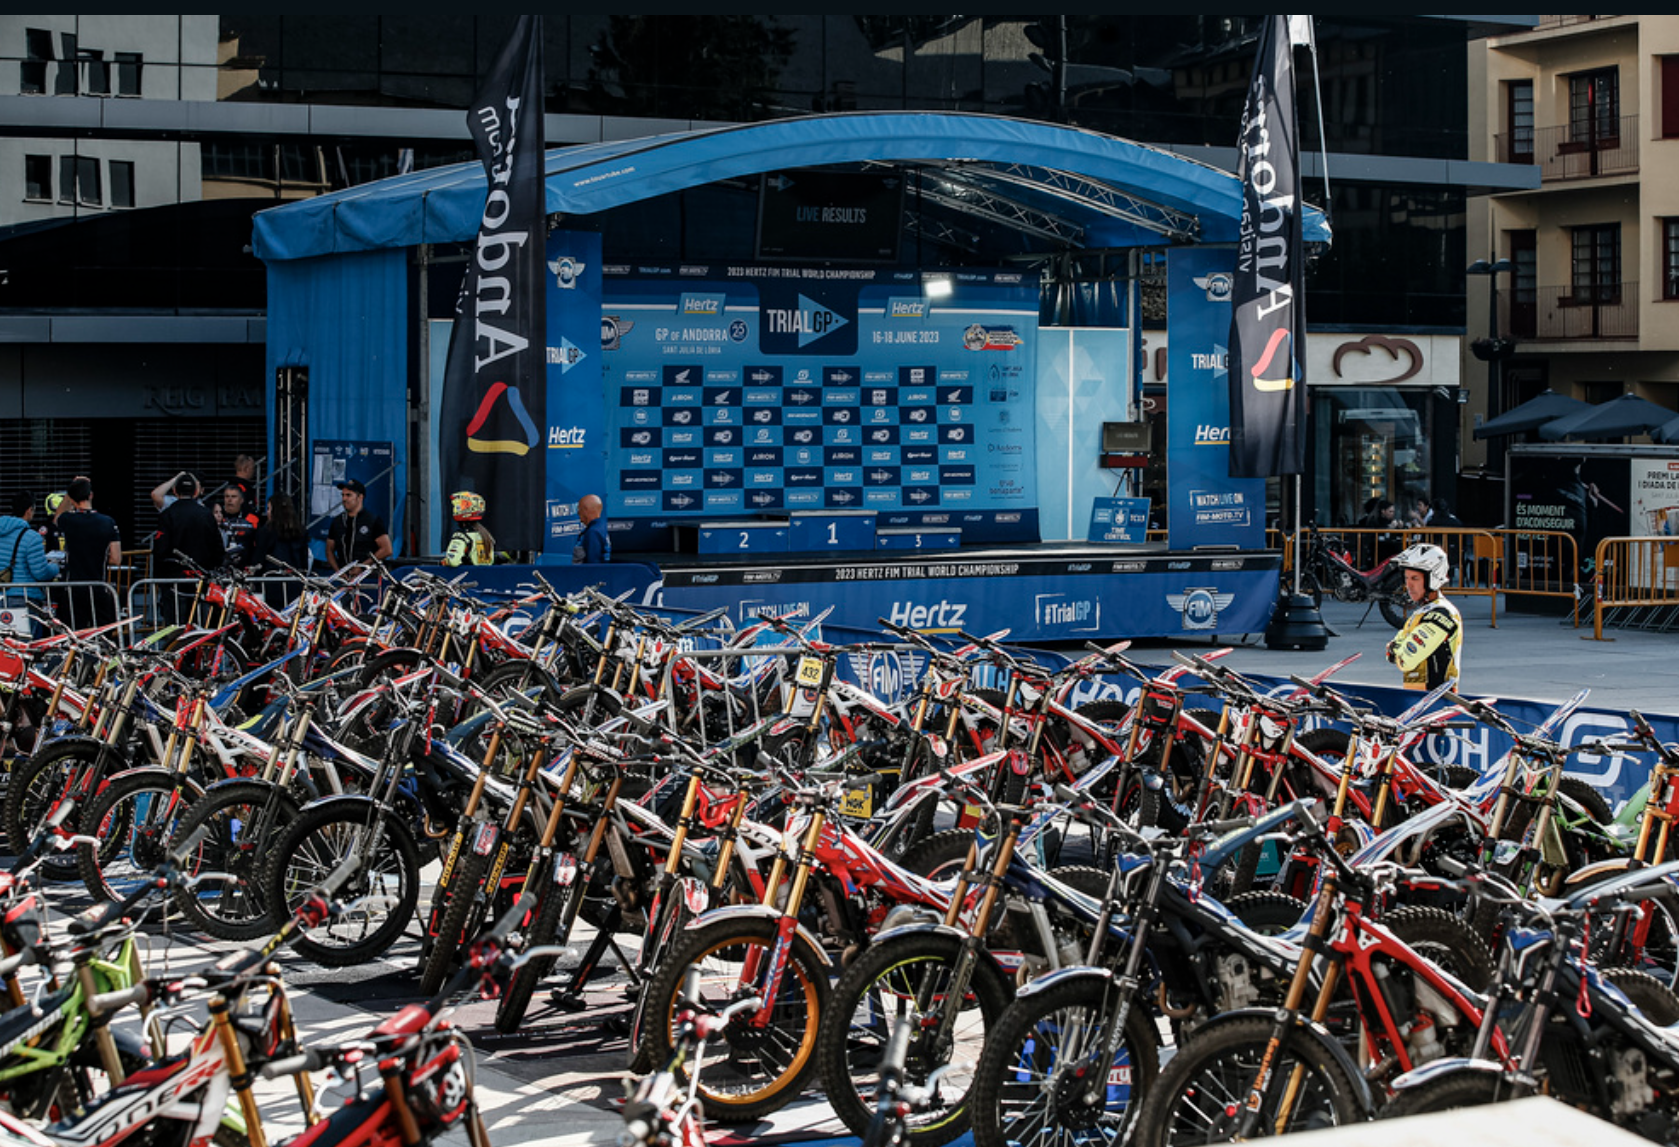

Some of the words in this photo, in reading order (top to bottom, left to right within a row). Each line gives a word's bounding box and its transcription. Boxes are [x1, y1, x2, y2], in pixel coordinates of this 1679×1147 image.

[797, 206, 820, 222] LIVE
[822, 207, 866, 223] RESULTS
[728, 267, 744, 276] 2023
[746, 267, 766, 277] HERTZ
[768, 268, 780, 277] FIM
[782, 268, 800, 278] TRIAL
[802, 269, 824, 279] WORLD
[826, 270, 875, 279] CHAMPIONSHIP
[684, 298, 718, 310] Hertz
[892, 302, 925, 314] Hertz
[655, 328, 669, 341] GP
[670, 331, 680, 341] OF
[683, 328, 728, 341] ANDORRA
[873, 331, 893, 343] 16-18
[894, 331, 917, 343] JUNE
[920, 331, 939, 343] 2023
[549, 426, 585, 444] Hertz
[1648, 471, 1669, 480] PREMI
[1643, 480, 1665, 489] DIADA
[1196, 494, 1219, 506] WATCH
[1220, 494, 1233, 505] LIVE
[1234, 493, 1244, 503] ON
[551, 504, 570, 518] WATCH
[1516, 502, 1526, 515] ÉS
[1527, 505, 1566, 516] MOMENT
[1516, 516, 1575, 529] D'ACONSEGUIR
[827, 522, 838, 543] 1
[739, 532, 749, 548] 2
[915, 534, 922, 547] 3
[836, 569, 855, 579] 2023
[857, 568, 883, 579] HERTZ
[885, 567, 900, 578] FIM
[902, 566, 925, 577] TRIAL
[928, 566, 955, 576] WORLD
[958, 564, 1019, 576] CHAMPIONSHIP
[748, 605, 777, 618] WATCH
[891, 600, 967, 627] Hertz
[1045, 600, 1091, 625] #TrialGP
[1188, 601, 1211, 617] FIM
[802, 666, 820, 679] 432
[873, 666, 898, 694] FIM
